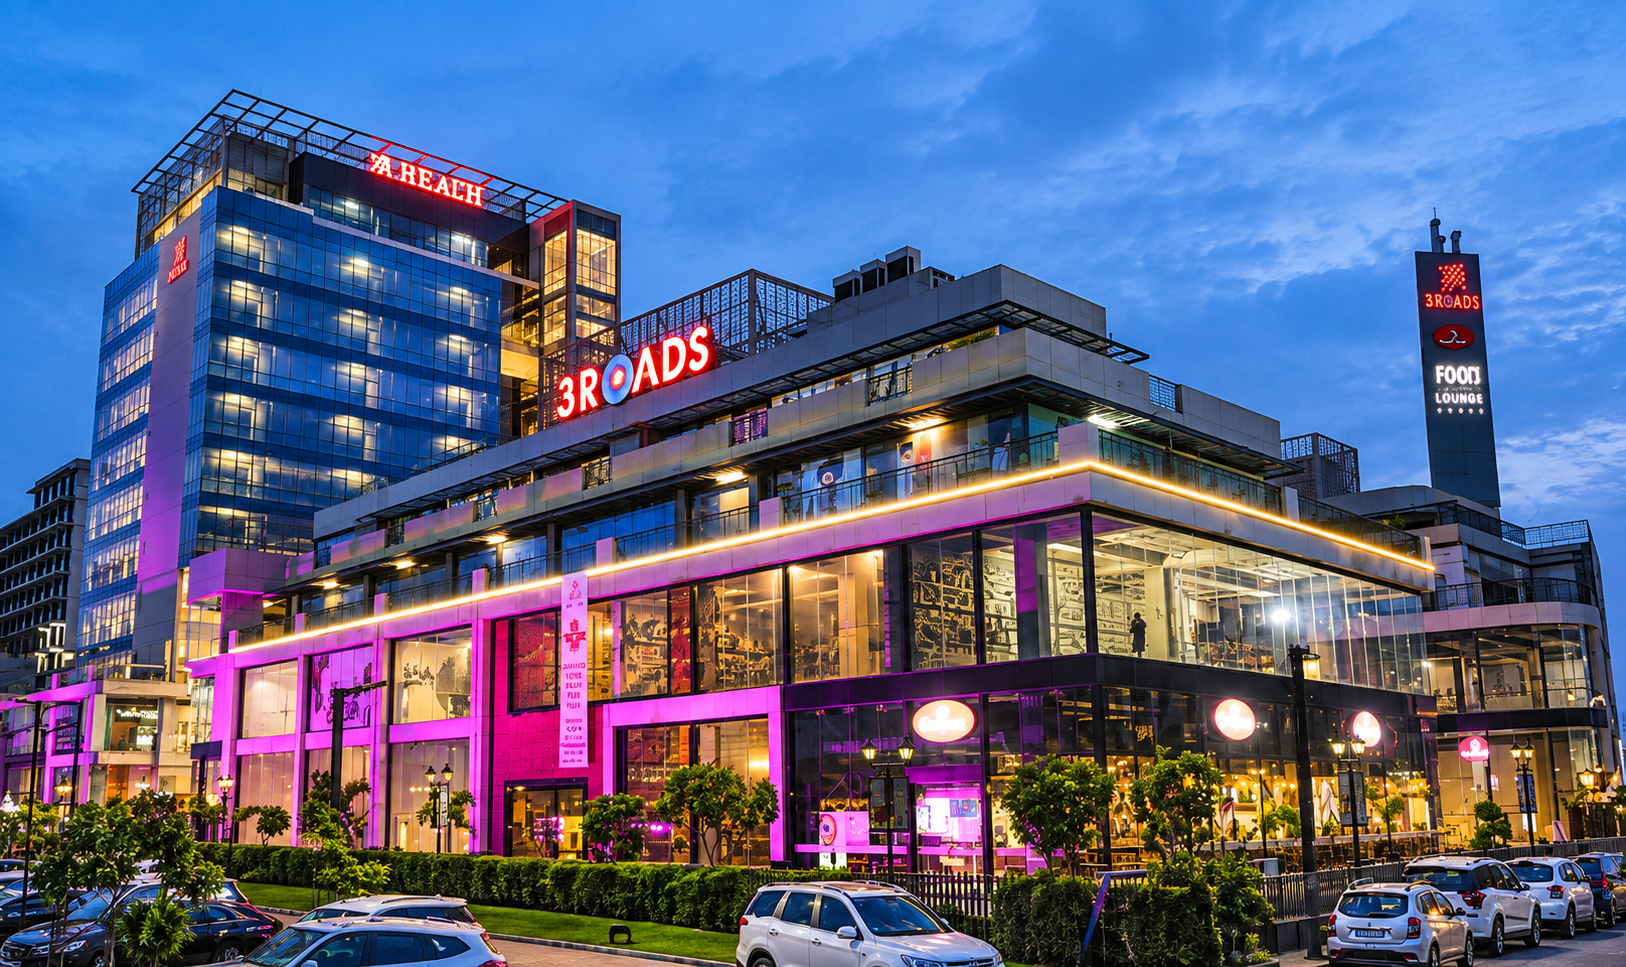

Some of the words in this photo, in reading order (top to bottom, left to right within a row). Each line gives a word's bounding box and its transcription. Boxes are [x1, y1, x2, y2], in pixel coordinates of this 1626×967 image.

[1425, 294, 1480, 310] 3ROADS
[556, 325, 709, 419] 3ROADS
[1435, 392, 1483, 404] LOUNGE
